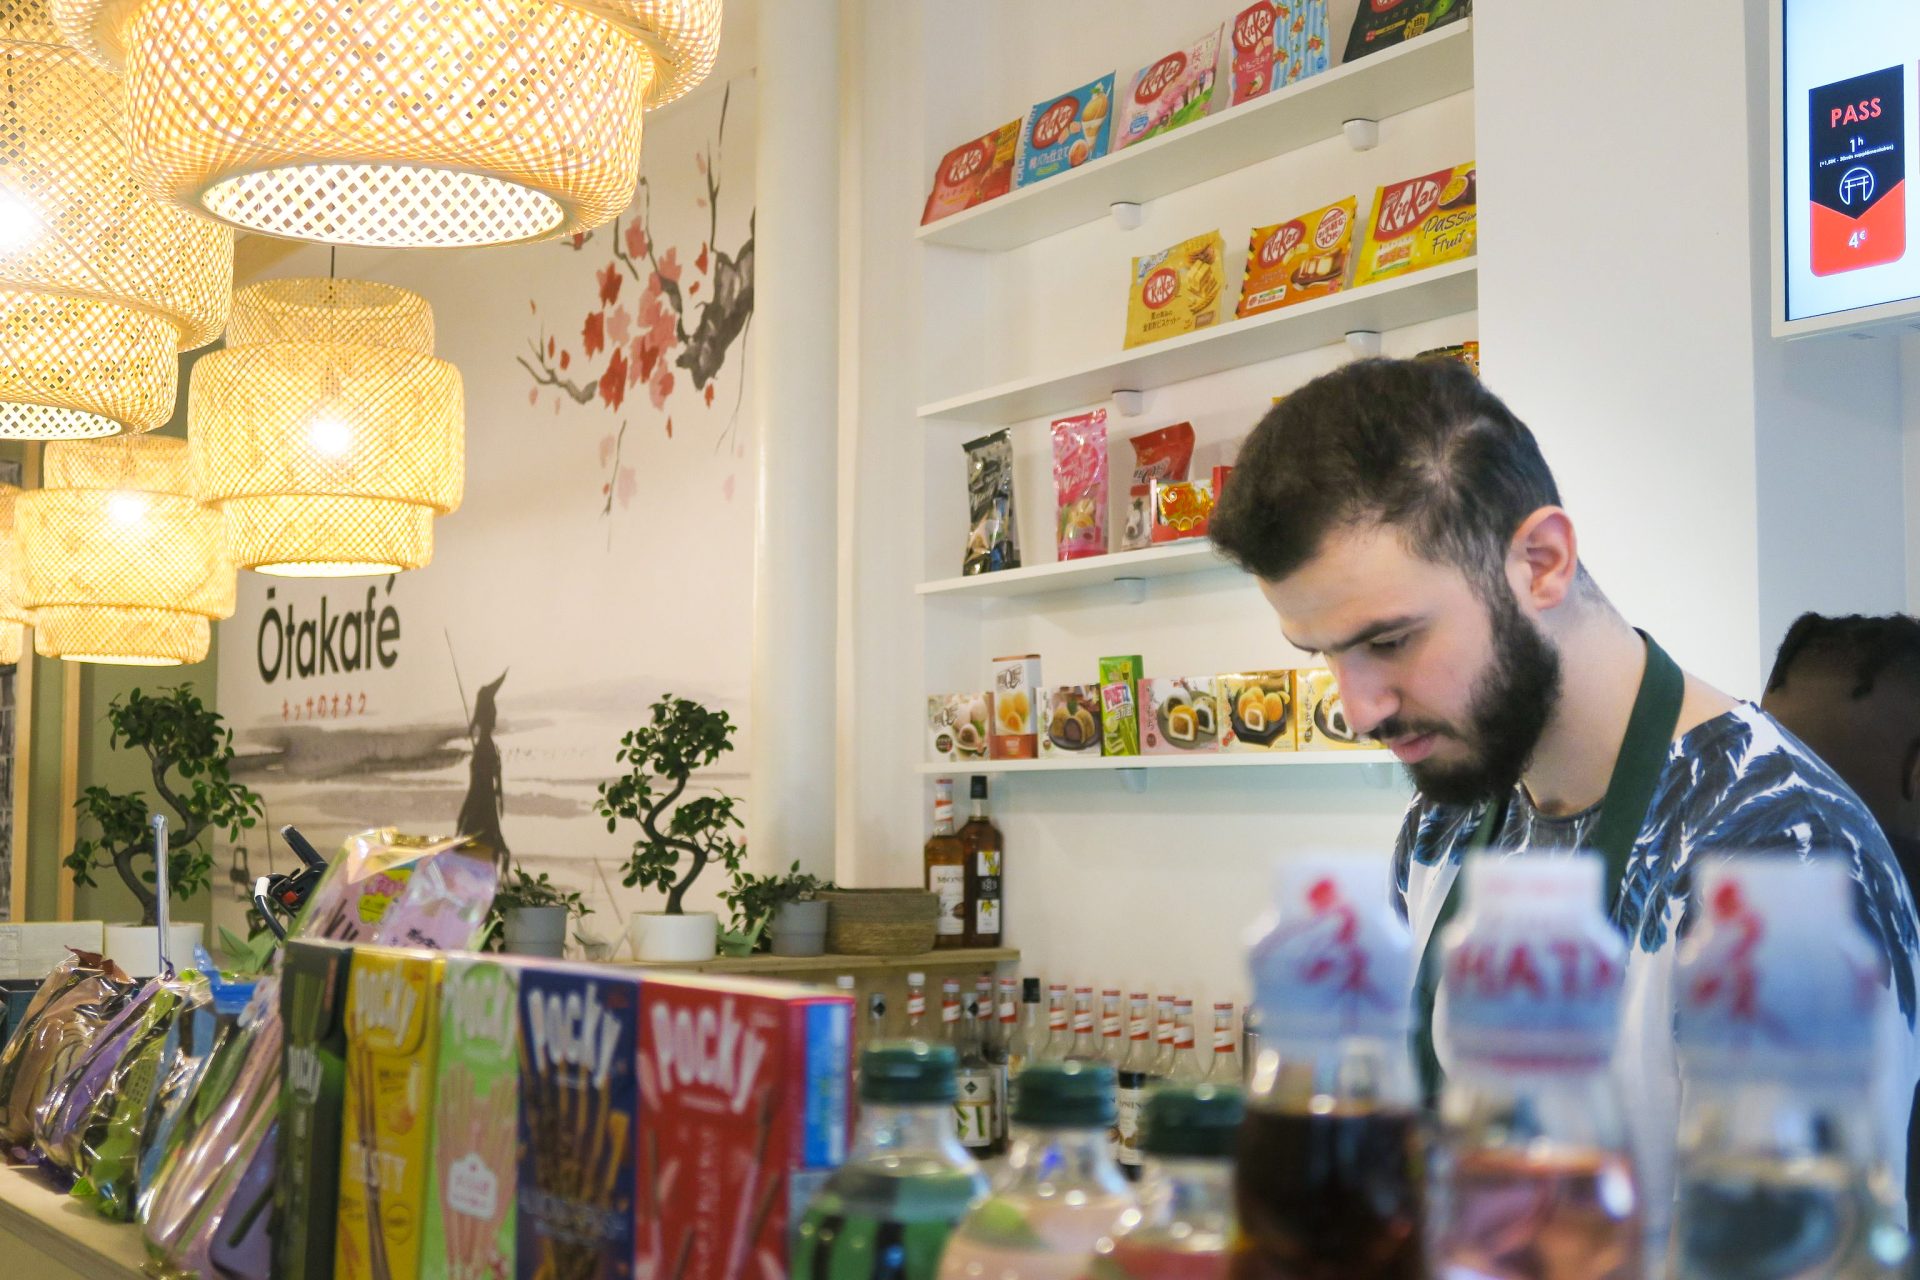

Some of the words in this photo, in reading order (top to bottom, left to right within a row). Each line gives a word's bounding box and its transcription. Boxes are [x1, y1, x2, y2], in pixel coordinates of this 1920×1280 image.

[1237, 9, 1271, 47] KitKat
[1831, 97, 1882, 129] PASS
[1378, 181, 1440, 233] KitKat
[1262, 227, 1299, 263] KitKat
[1431, 229, 1467, 255] Fruit
[1146, 274, 1175, 304] KitKat
